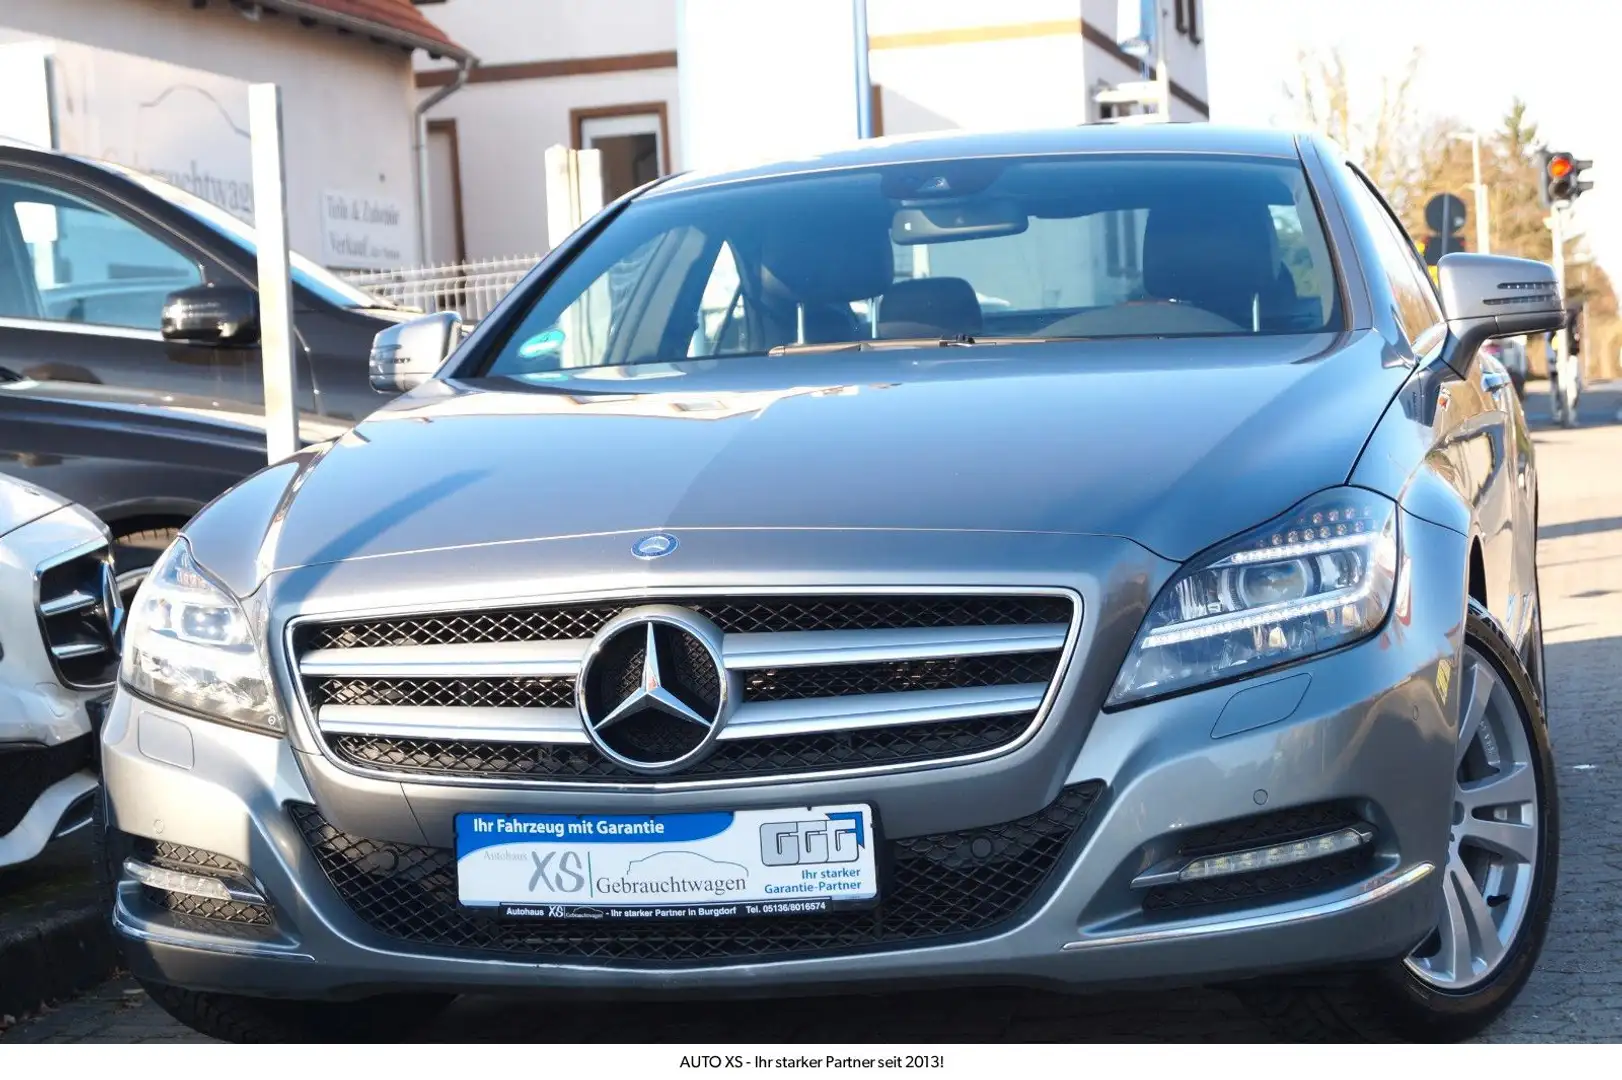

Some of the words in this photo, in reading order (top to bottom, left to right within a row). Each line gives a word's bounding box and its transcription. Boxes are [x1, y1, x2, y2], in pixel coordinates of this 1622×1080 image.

[473, 818, 494, 834] Ihr
[497, 818, 565, 837] Fahrzeug
[568, 820, 594, 834] mit
[597, 820, 665, 835] Garantie
[483, 849, 528, 861] Autohaus
[528, 851, 585, 893] XS
[596, 876, 746, 896] Gebrauchtwagen
[801, 869, 817, 880] Ihr
[820, 867, 861, 879] starker
[764, 881, 862, 894] Garantie-Partner
[506, 907, 545, 916] Autohaus
[548, 906, 564, 918] XS
[611, 909, 623, 917] Ihr
[624, 909, 653, 917] starker
[655, 908, 687, 917] Partner
[699, 906, 737, 917] Burgdorf
[746, 905, 761, 914] Tel.
[763, 902, 826, 913] 05136/8016574
